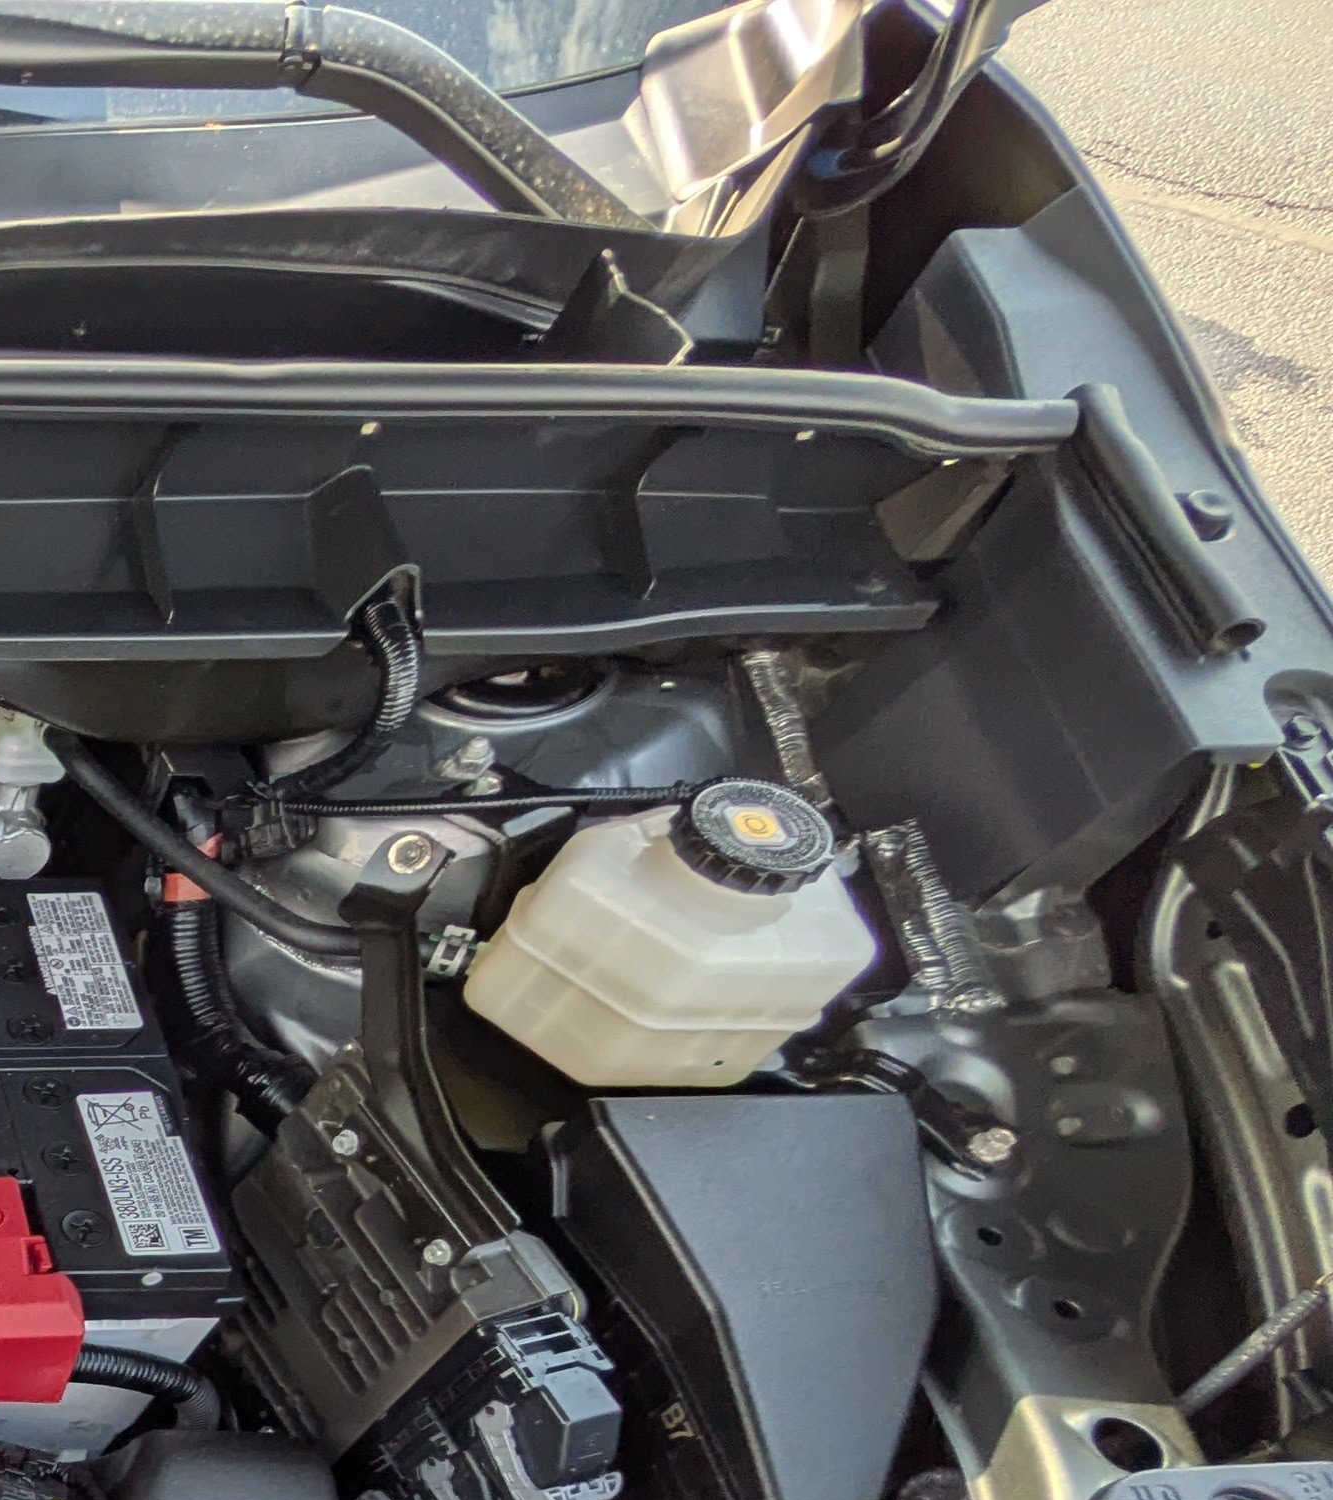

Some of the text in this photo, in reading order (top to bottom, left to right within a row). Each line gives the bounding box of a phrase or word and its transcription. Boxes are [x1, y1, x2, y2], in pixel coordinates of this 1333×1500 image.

[139, 1105, 153, 1120] Pb
[100, 1157, 140, 1219] 380LN3-ISS
[182, 1228, 209, 1247] TM
